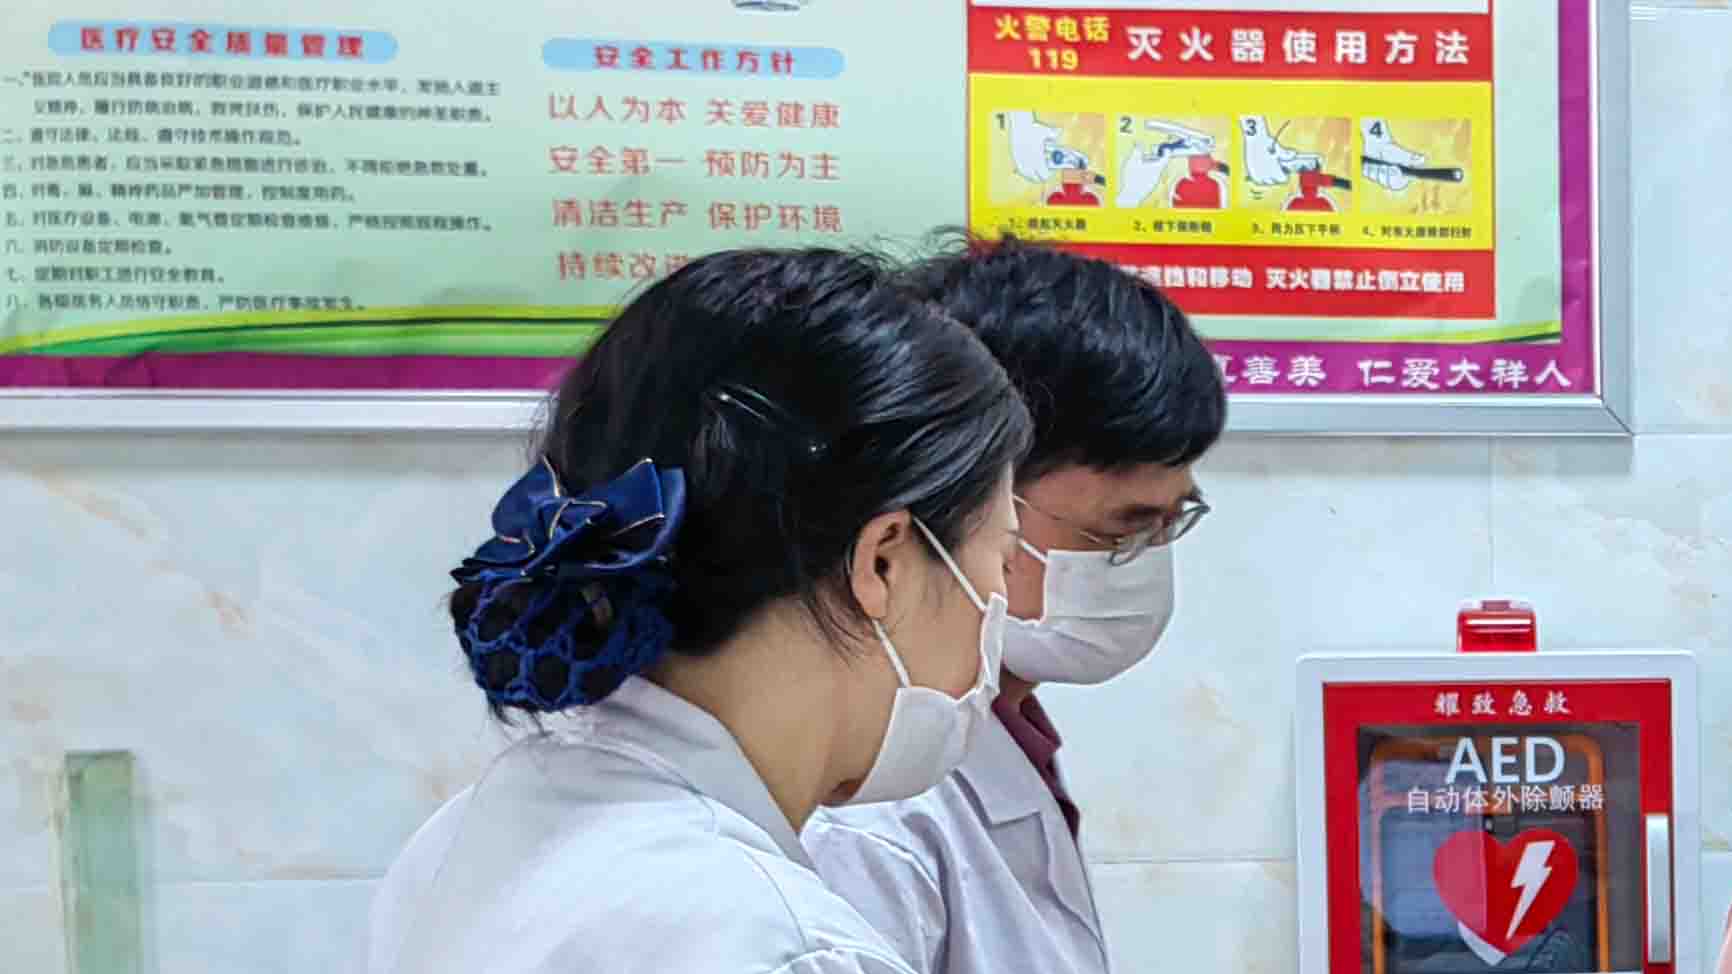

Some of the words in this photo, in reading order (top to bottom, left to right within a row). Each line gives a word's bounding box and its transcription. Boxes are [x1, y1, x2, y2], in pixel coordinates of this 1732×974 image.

[80, 27, 364, 58] 医疗安全质量管理
[995, 15, 1110, 44] 火警电话
[594, 46, 798, 74] 安全工作方针
[1029, 47, 1079, 70] 119
[1126, 28, 1470, 65] 灭火器使用方法
[548, 94, 687, 123] 以人为本
[704, 99, 840, 129] 关爱健康
[996, 113, 1006, 130] 1
[1119, 116, 1132, 134] 2
[1245, 119, 1257, 137] 3
[1369, 121, 1383, 138] 4
[549, 146, 687, 175] 安全第一
[705, 150, 840, 181] 预防为主
[553, 198, 688, 227] 清洁生产
[708, 203, 843, 232] 保护环境
[1120, 265, 1252, 289] 挡和移动
[1359, 357, 1572, 389] 仁爱大祥人
[1434, 690, 1572, 717] 耀致急救
[1445, 736, 1566, 784] AED
[1407, 785, 1605, 816] 自动体外除颤器
